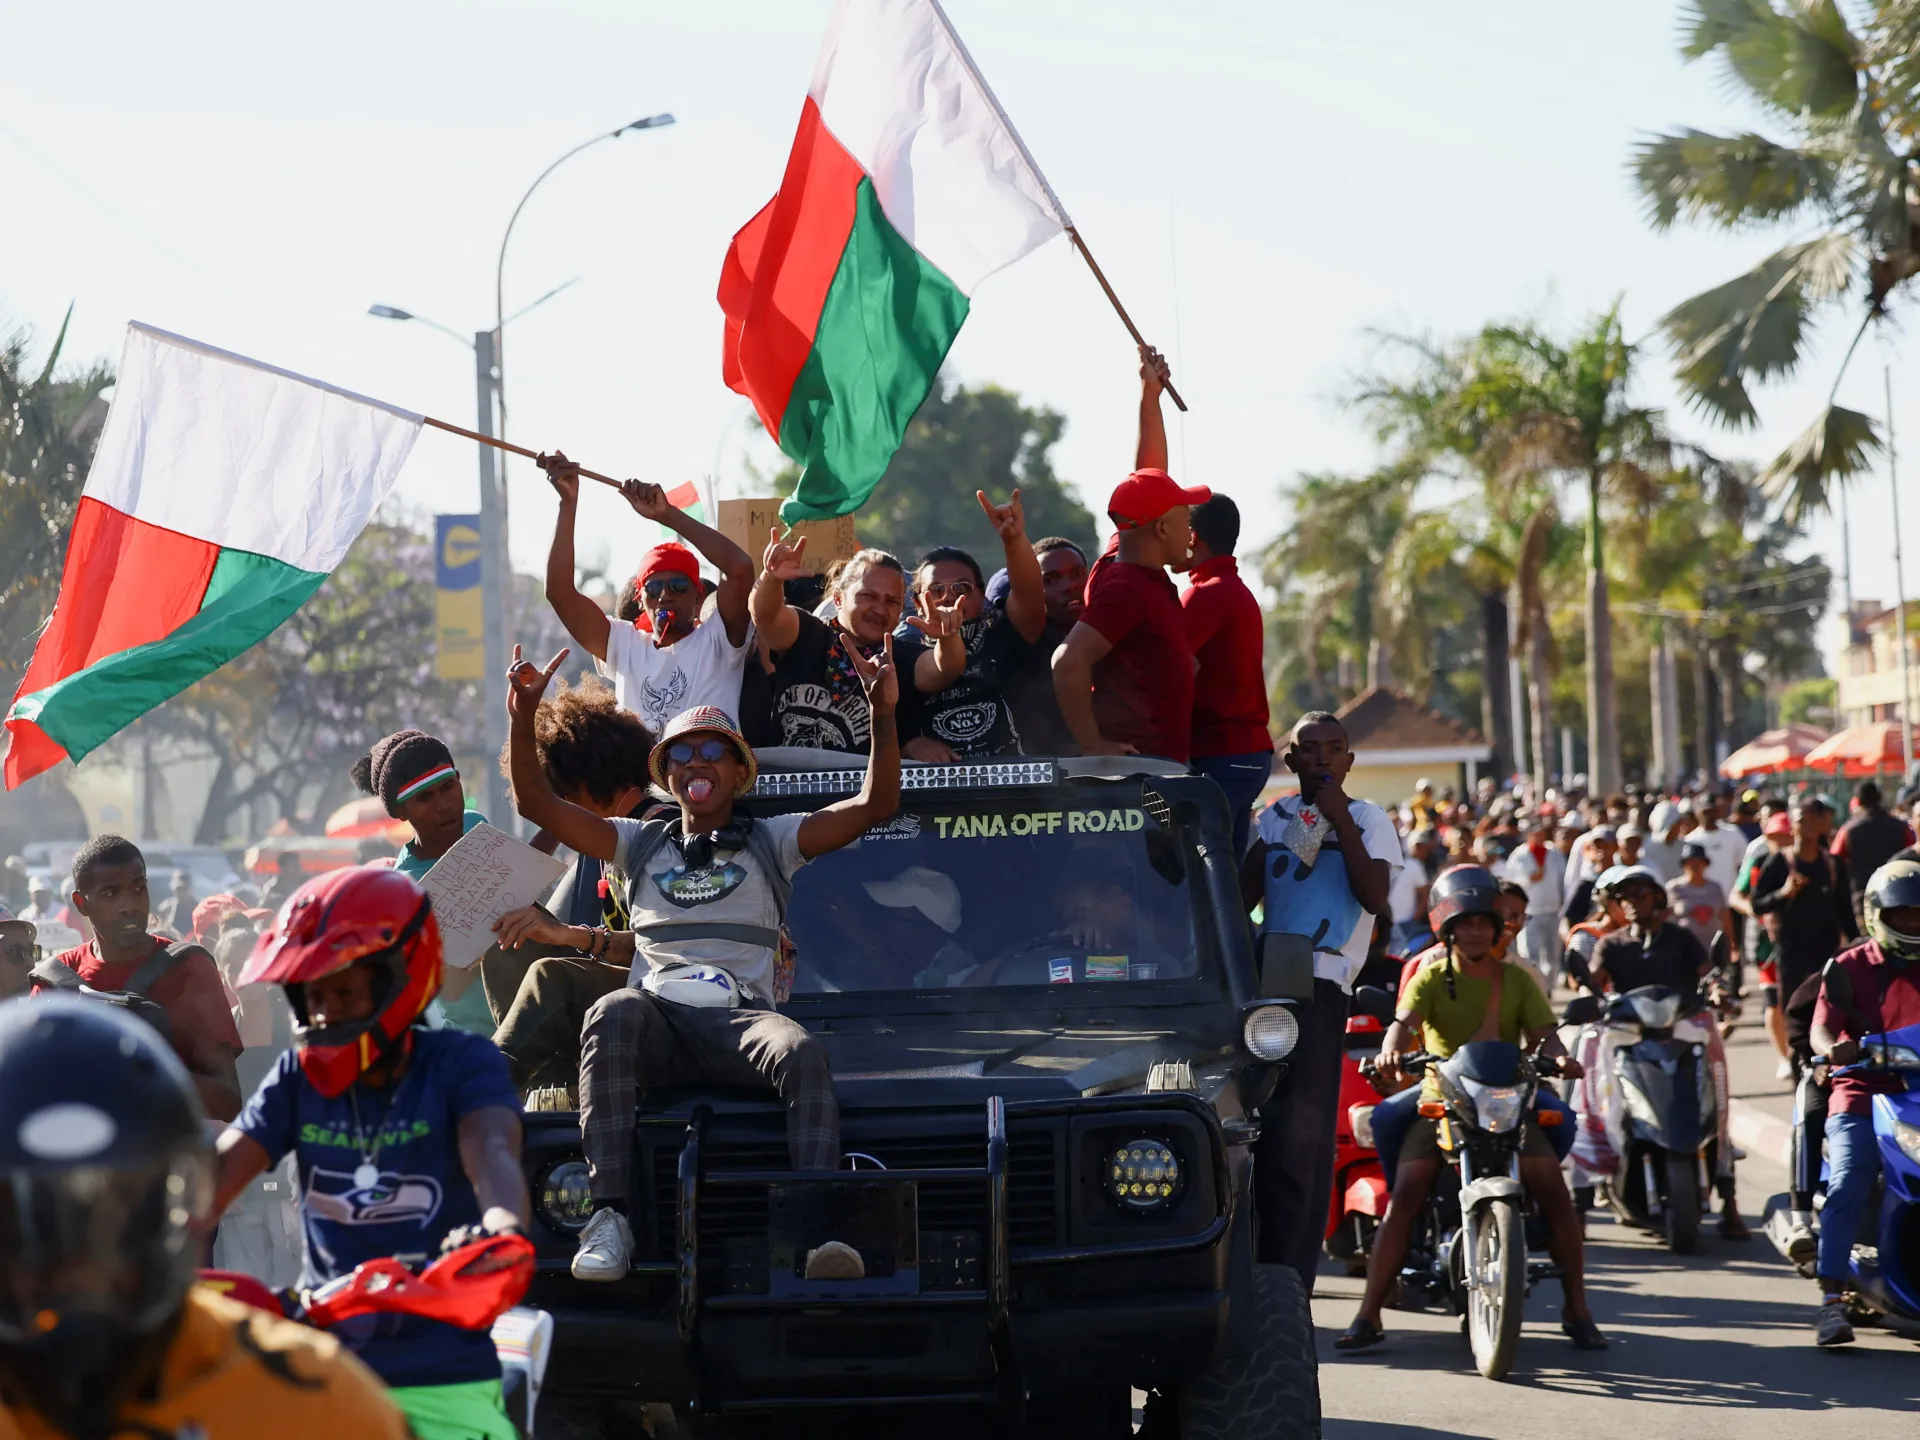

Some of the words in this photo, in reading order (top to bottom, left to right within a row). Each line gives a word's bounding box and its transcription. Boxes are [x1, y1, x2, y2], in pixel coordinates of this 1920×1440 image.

[804, 686, 828, 706] OF
[956, 711, 973, 719] Old
[934, 814, 1008, 839] TANA
[1010, 812, 1063, 836] OFF
[1068, 808, 1144, 834] ROAD
